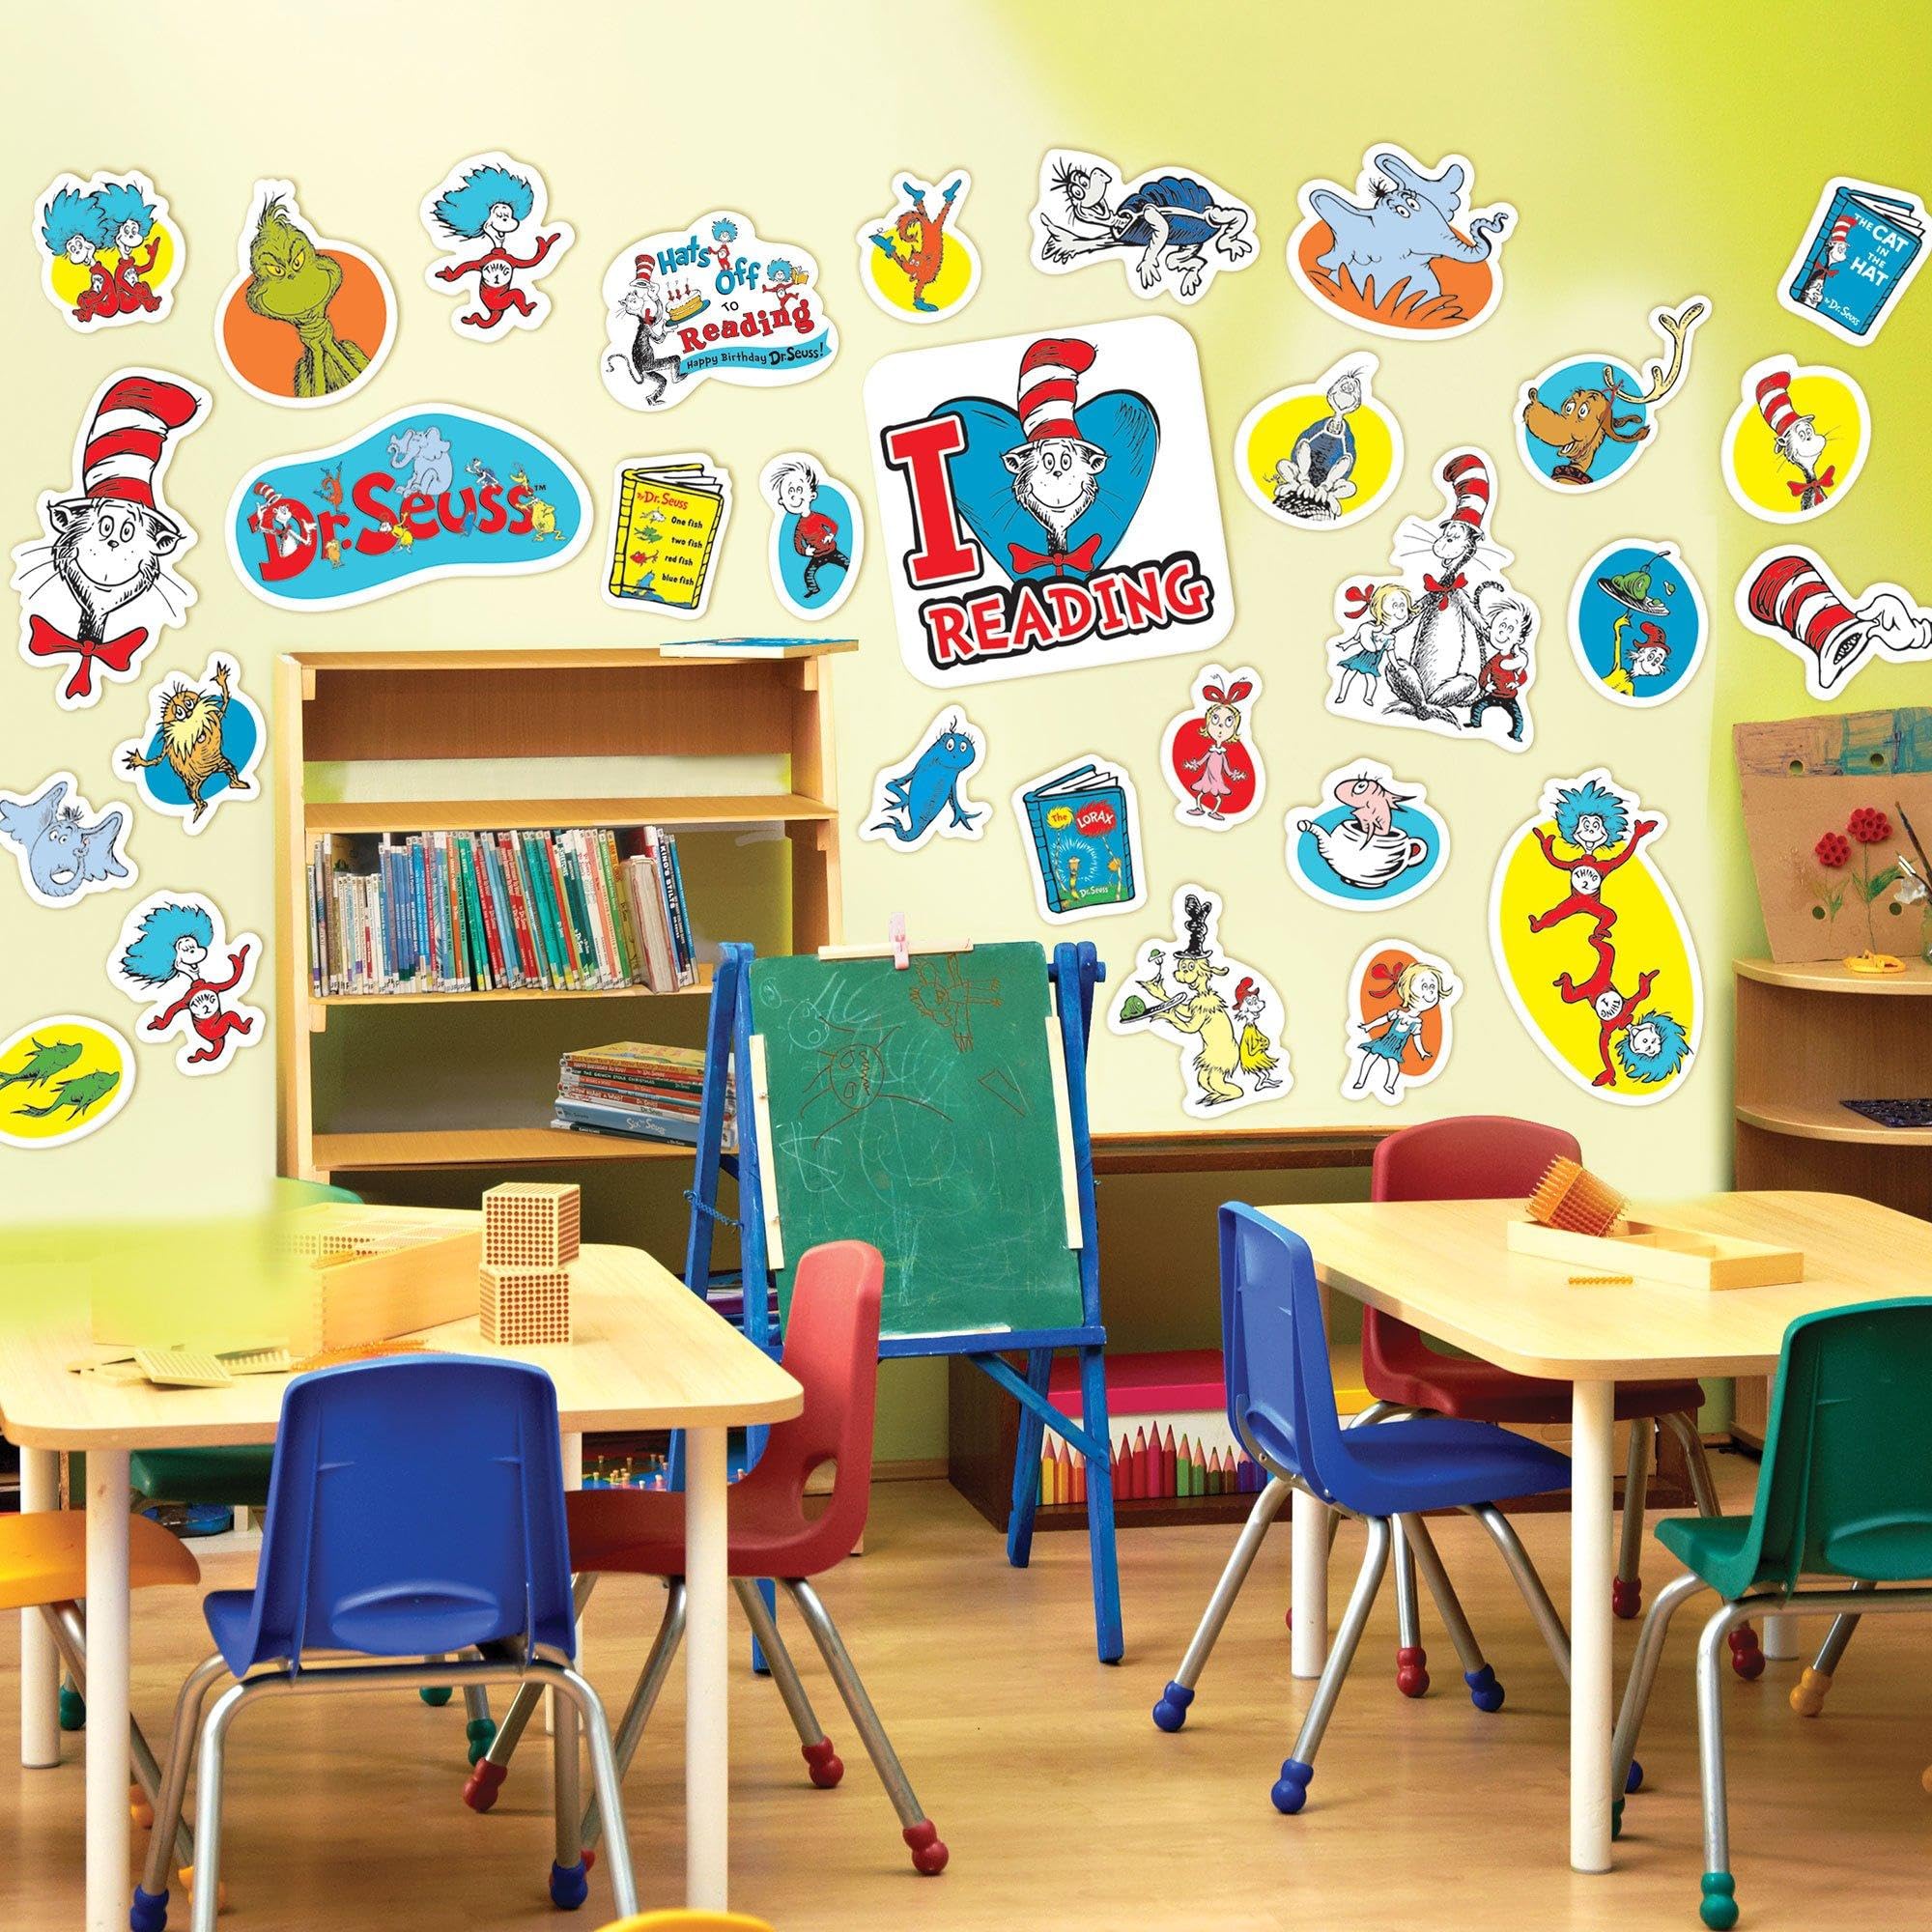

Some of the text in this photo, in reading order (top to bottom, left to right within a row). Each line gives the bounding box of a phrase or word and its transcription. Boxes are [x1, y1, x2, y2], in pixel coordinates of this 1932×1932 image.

[1854, 213, 1909, 253] THE CAT
[1876, 245, 1889, 257] IN
[657, 235, 760, 295] Hats Off
[1867, 253, 1886, 268] THE
[484, 263, 509, 275] THING
[1850, 257, 1889, 287] HAT
[494, 274, 499, 284] 1
[722, 300, 739, 313] TO
[1829, 298, 1840, 313] Dr.
[1840, 307, 1861, 327] Seuss
[677, 299, 815, 354] Reading
[687, 353, 718, 369] Happy
[721, 353, 766, 364] Birthday
[643, 491, 659, 503] Dr.
[662, 494, 688, 510] Seuss
[885, 415, 980, 586] I
[250, 498, 352, 582] Dr.
[353, 471, 533, 555] Seuss
[671, 517, 702, 528] One fish
[671, 537, 702, 549] two fish
[665, 554, 693, 566] red fish
[662, 574, 694, 586] blue fish
[923, 558, 1210, 665] READING
[1051, 810, 1114, 829] The LORAX
[660, 845, 670, 876] KING'S
[666, 878, 675, 909] STILTS
[1575, 868, 1598, 882] THING
[1080, 886, 1109, 897] Dr. Seuss
[1581, 881, 1589, 890] 2
[191, 993, 215, 1009] THING
[1601, 1000, 1621, 1017] THING
[202, 1005, 212, 1014] 2
[628, 1076, 655, 1085] CHRISTMAS
[626, 1117, 639, 1130] Six
[645, 1119, 667, 1136] Seuss
